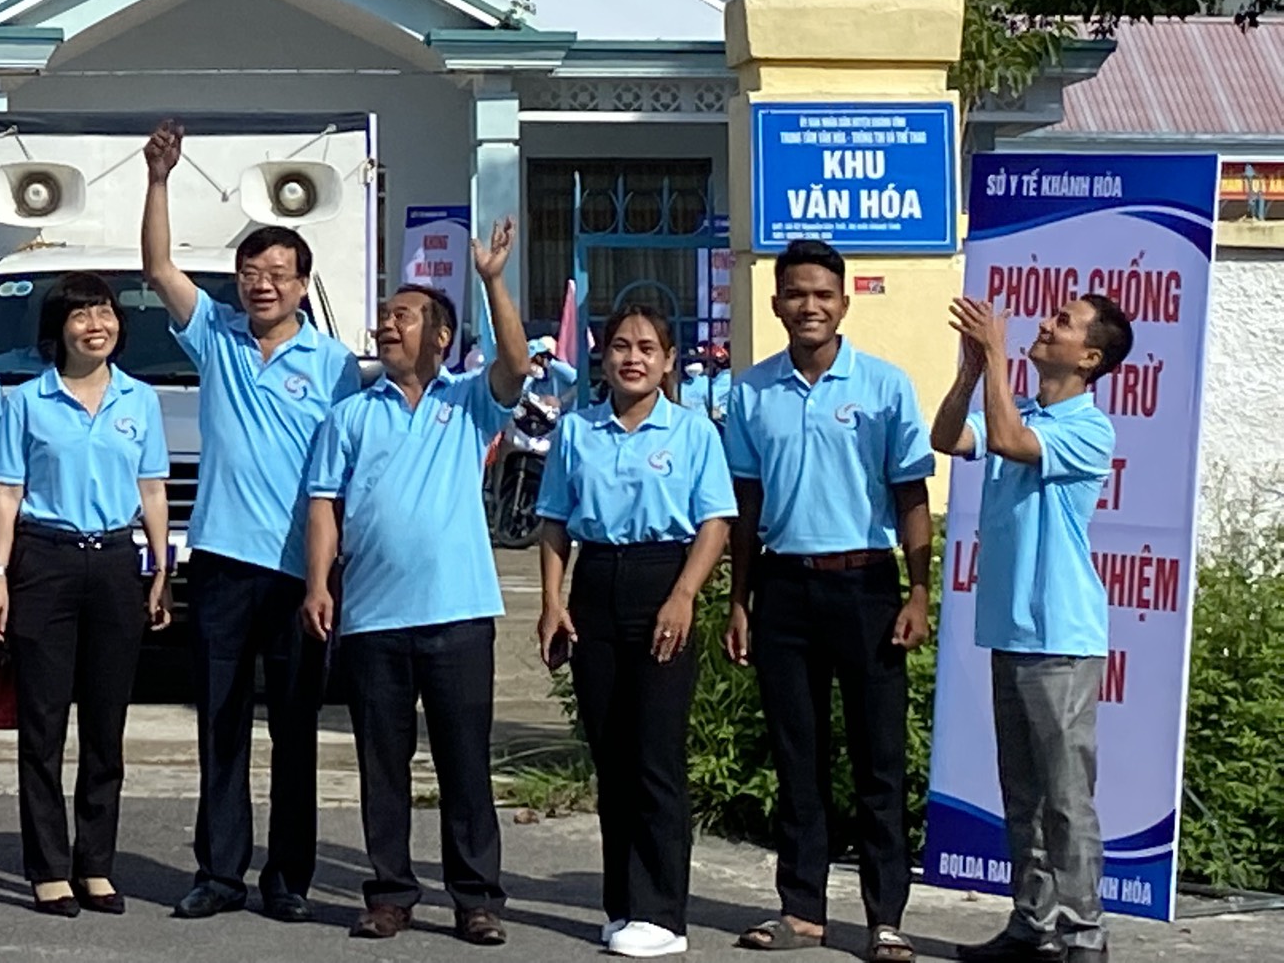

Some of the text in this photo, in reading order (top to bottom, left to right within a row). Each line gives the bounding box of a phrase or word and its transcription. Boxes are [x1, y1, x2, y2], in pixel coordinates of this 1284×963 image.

[823, 150, 885, 179] KHU
[986, 167, 1006, 196] SỞ
[1010, 175, 1018, 196] Y
[1021, 168, 1040, 196] TẾ
[1041, 170, 1090, 197] KHÁNH
[787, 182, 922, 219] VĂN HÓA
[988, 253, 1078, 318] PHÒNG
[939, 852, 984, 880] BQLDA
